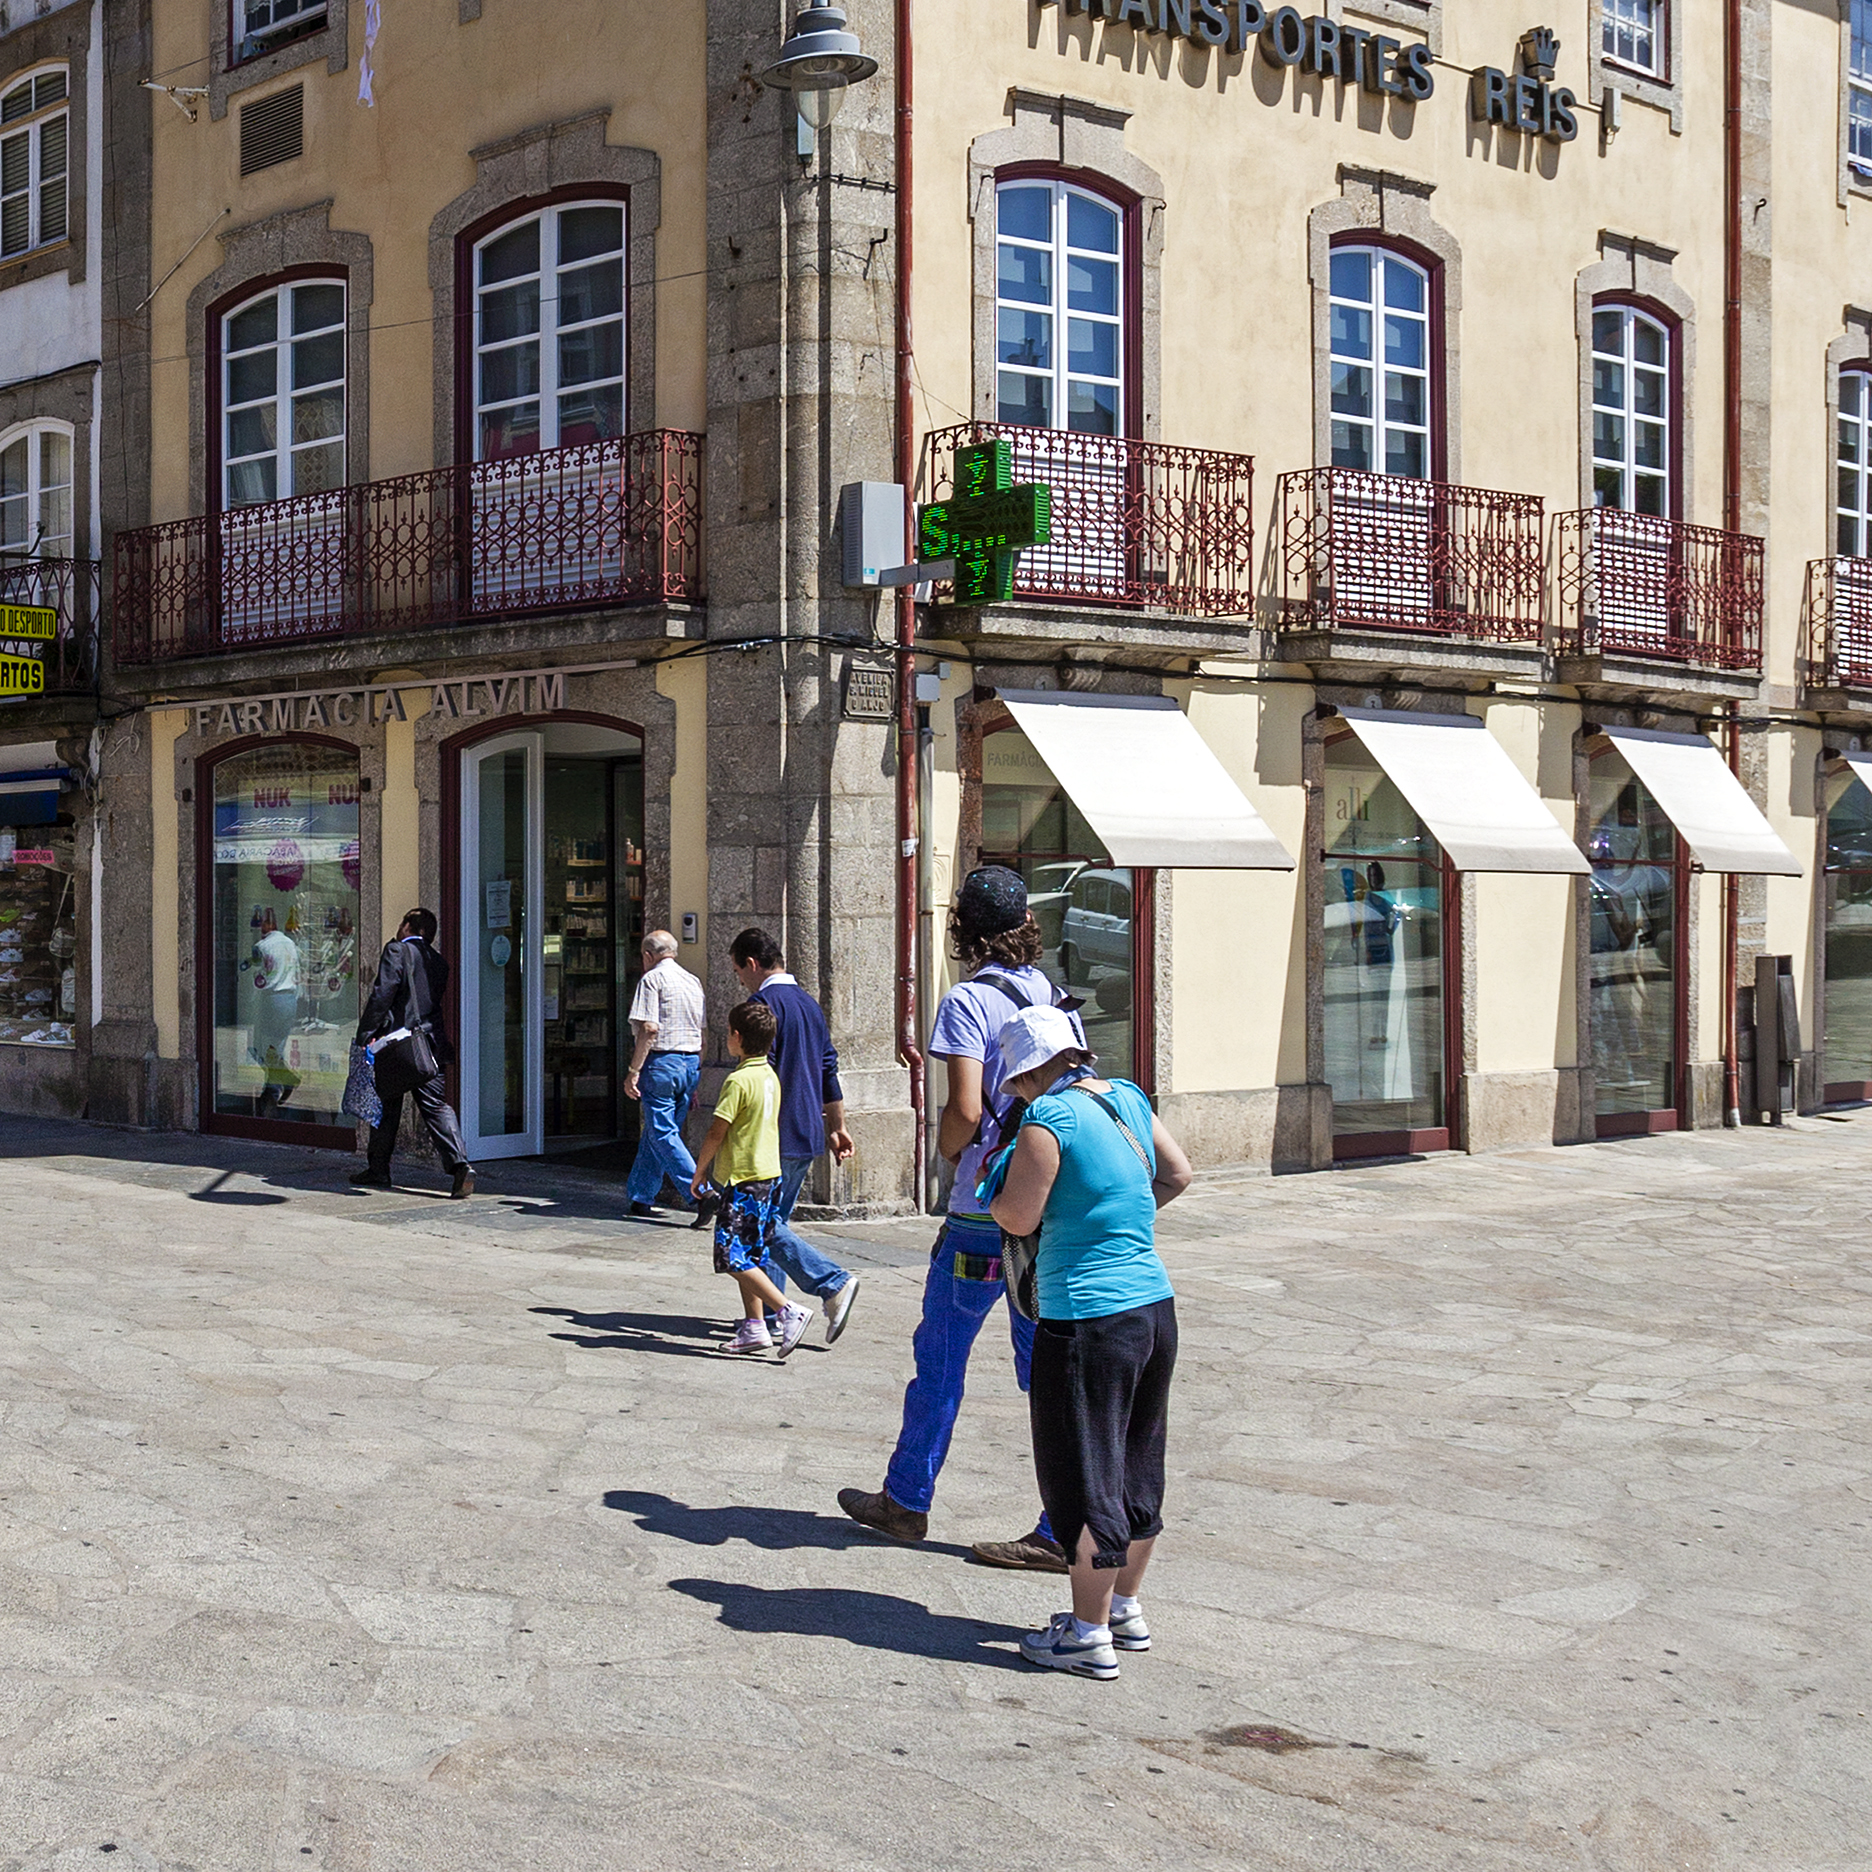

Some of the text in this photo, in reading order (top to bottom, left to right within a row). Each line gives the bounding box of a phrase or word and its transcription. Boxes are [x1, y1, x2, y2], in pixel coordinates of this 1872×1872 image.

[1473, 65, 1578, 142] REIS
[8, 609, 54, 637] DESPORTO
[195, 674, 565, 737] FARMÁCIA ALVIM
[253, 786, 292, 809] NUK
[1336, 787, 1370, 821] alli
